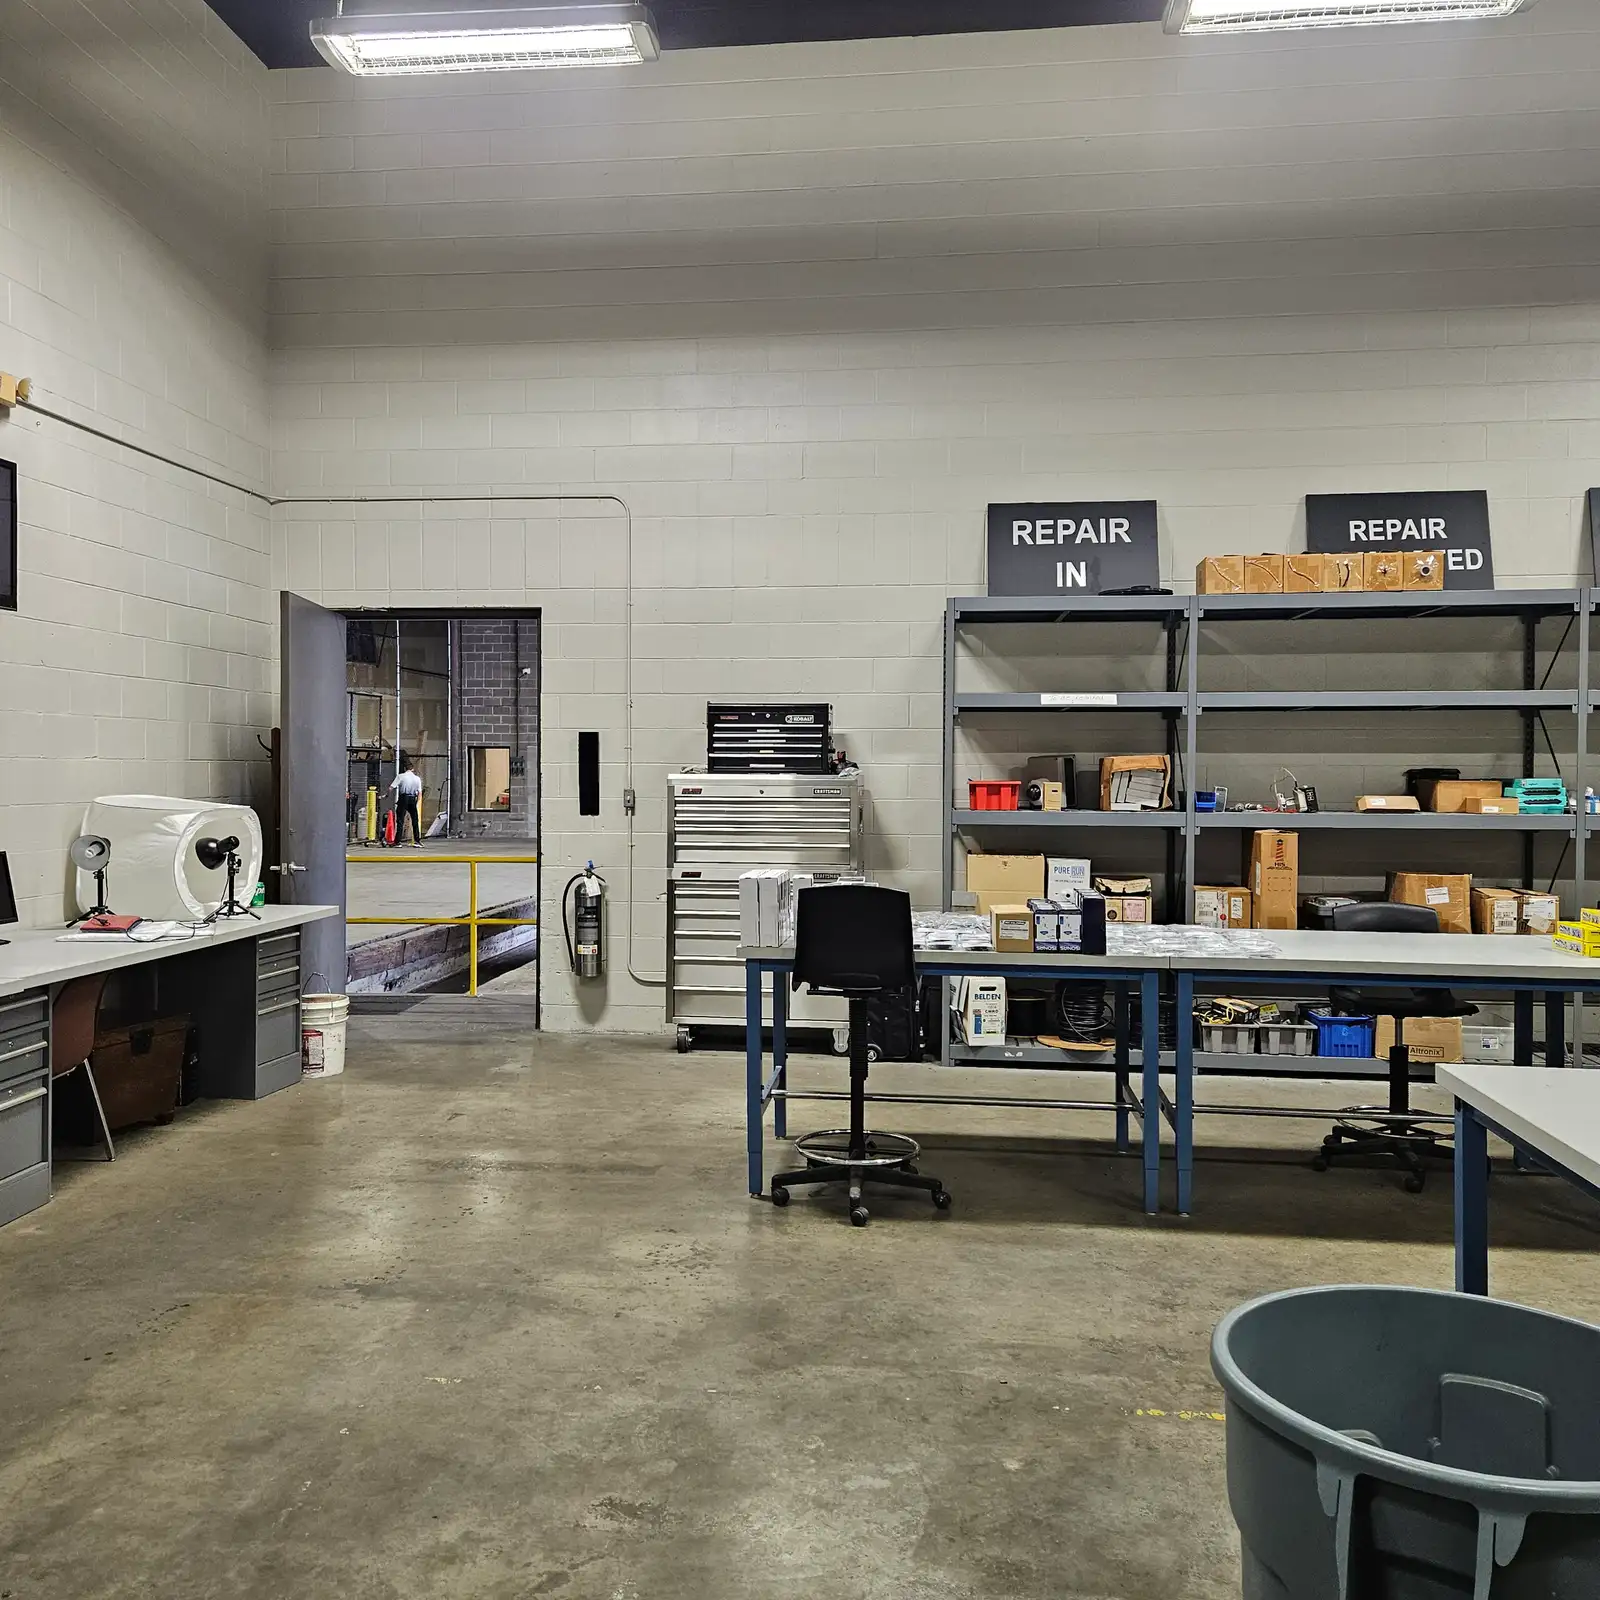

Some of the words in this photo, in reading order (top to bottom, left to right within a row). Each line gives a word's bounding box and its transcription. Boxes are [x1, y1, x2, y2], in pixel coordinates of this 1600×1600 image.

[1012, 518, 1132, 546] REPAIR
[1349, 518, 1448, 542] REPAIR
[1056, 561, 1087, 588] IN
[1053, 866, 1071, 874] PURE
[1071, 866, 1085, 876] RUN
[1409, 1046, 1441, 1056] Altronix
